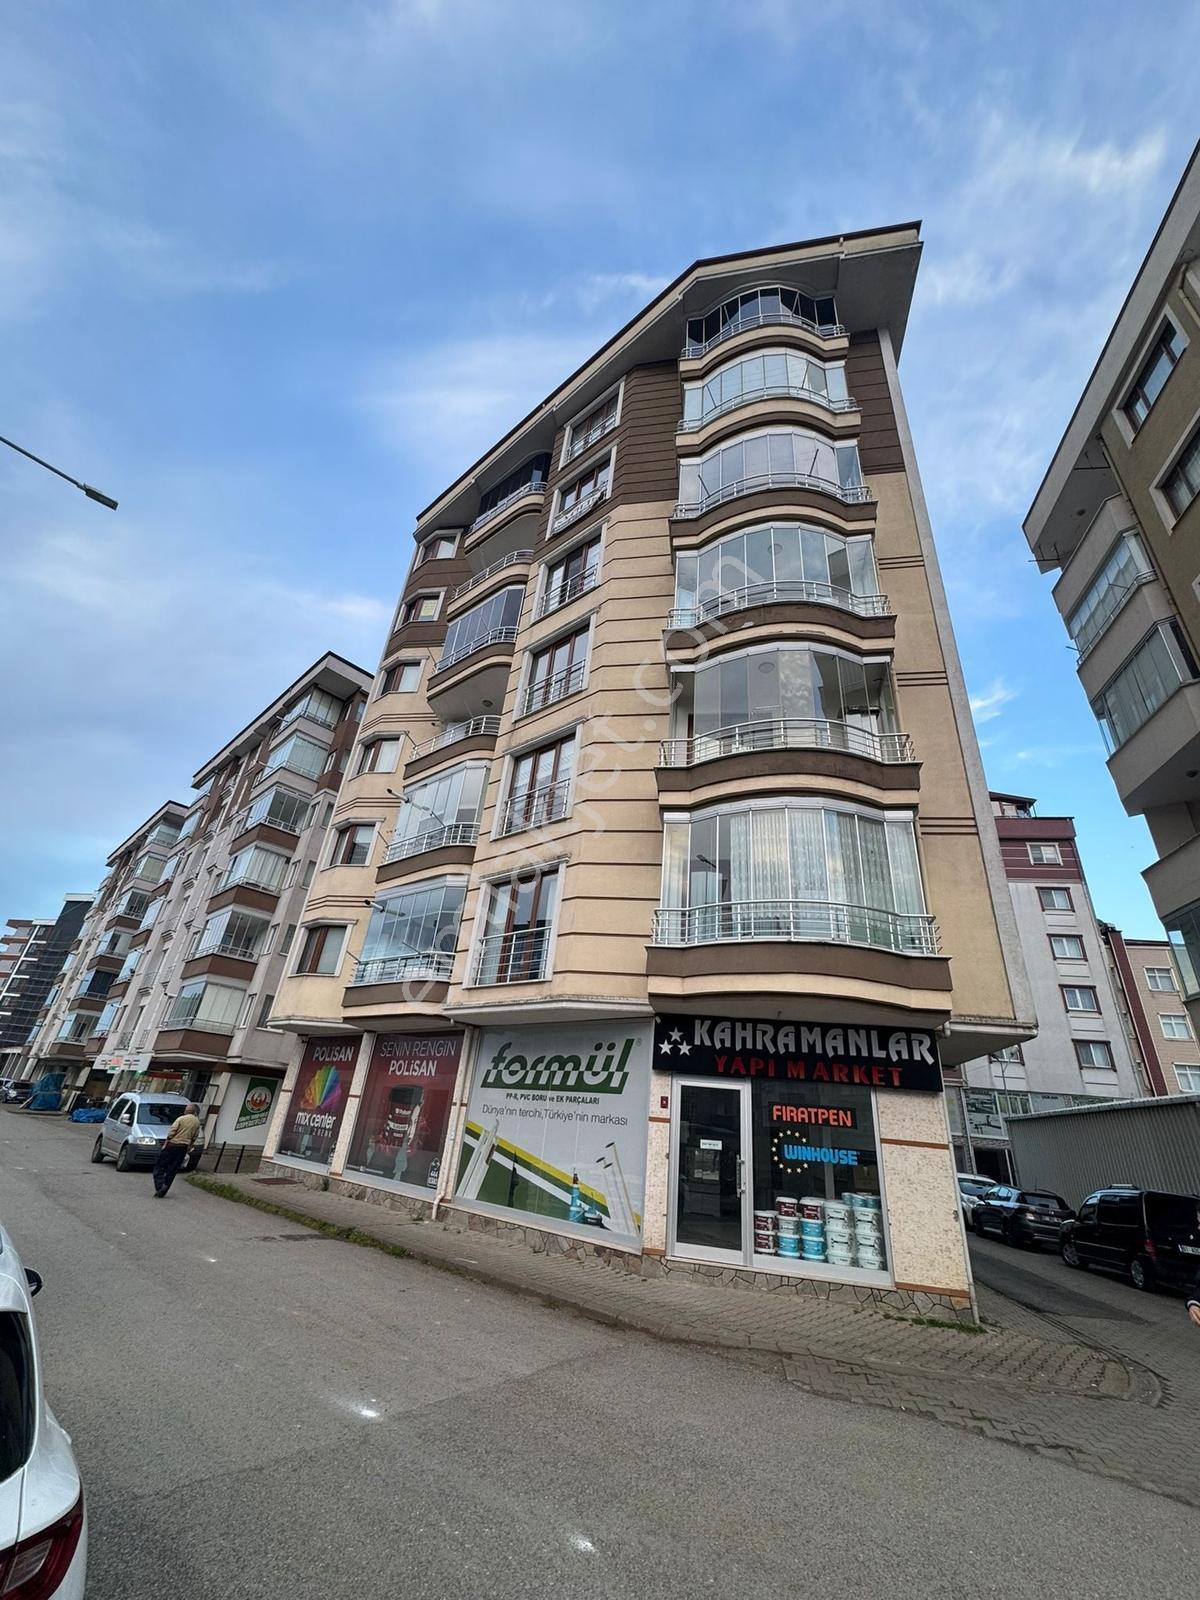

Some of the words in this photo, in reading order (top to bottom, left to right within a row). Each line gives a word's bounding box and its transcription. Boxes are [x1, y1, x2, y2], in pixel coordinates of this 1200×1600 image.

[694, 1019, 935, 1065] KAHRAMANLAR
[486, 1038, 635, 1088] formül
[714, 1054, 775, 1077] YAPI
[787, 1060, 903, 1087] MARKET
[519, 1093, 531, 1101] PVC
[532, 1094, 548, 1102] BORU
[556, 1095, 564, 1103] EK
[294, 1111, 311, 1126] mix
[310, 1112, 337, 1129] center
[591, 1114, 628, 1126] markası
[772, 1104, 853, 1127] FIRATPEN
[783, 1143, 858, 1166] WINHOUSE
